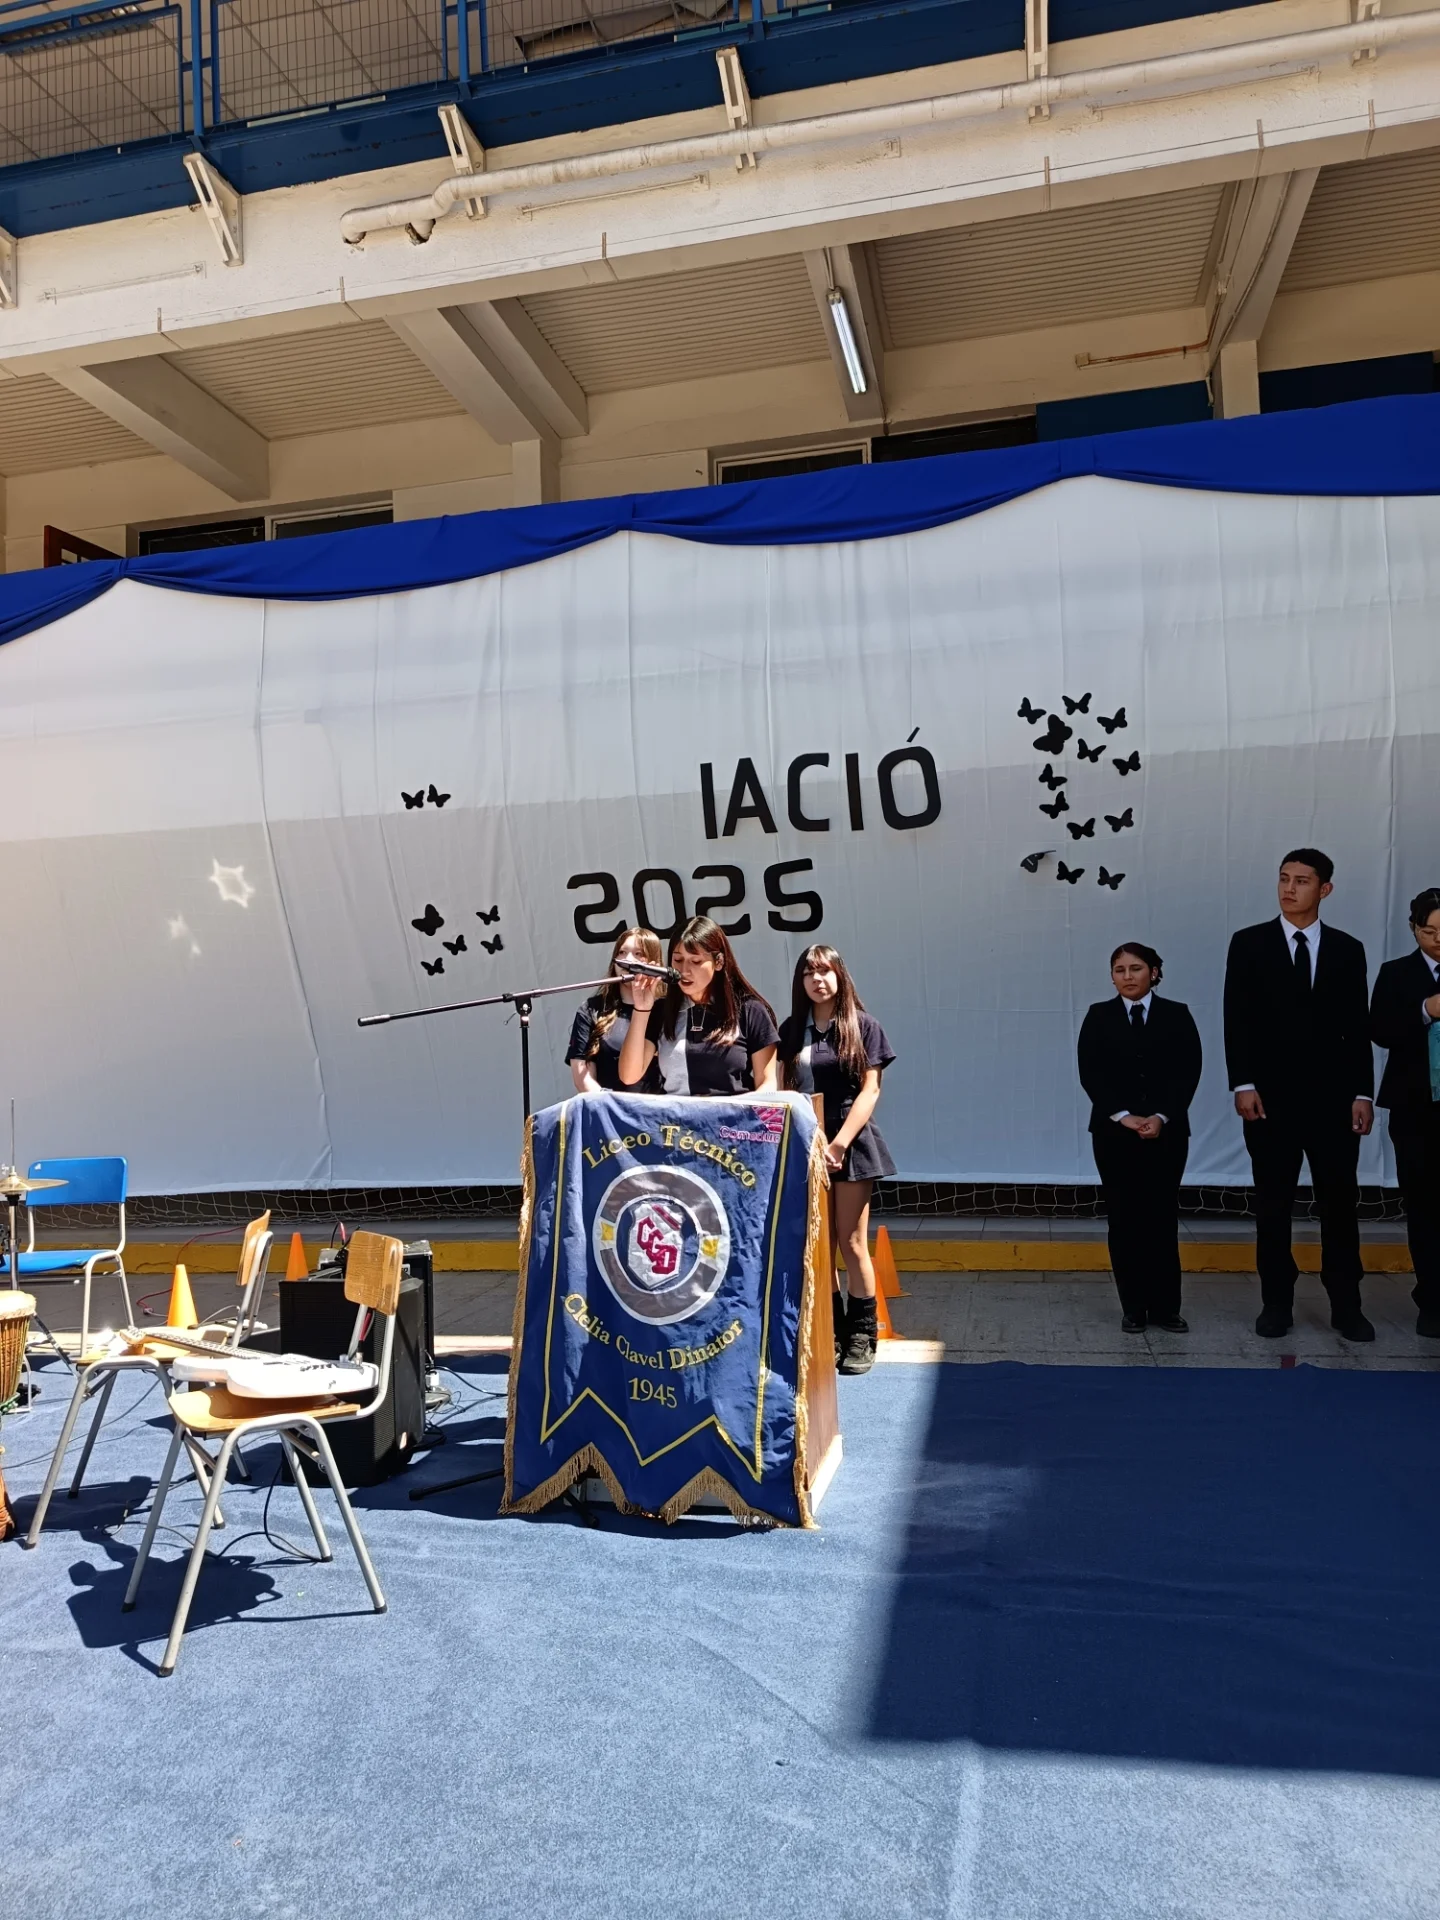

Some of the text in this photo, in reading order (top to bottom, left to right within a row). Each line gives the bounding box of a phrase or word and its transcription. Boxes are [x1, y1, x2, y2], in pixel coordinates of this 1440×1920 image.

[700, 727, 942, 840] IACIÓ
[566, 857, 824, 944] 2025
[582, 1125, 756, 1187] Liceo Técnico
[564, 1293, 744, 1371] Clelia Clavel Dinator
[628, 1377, 678, 1409] 1945
